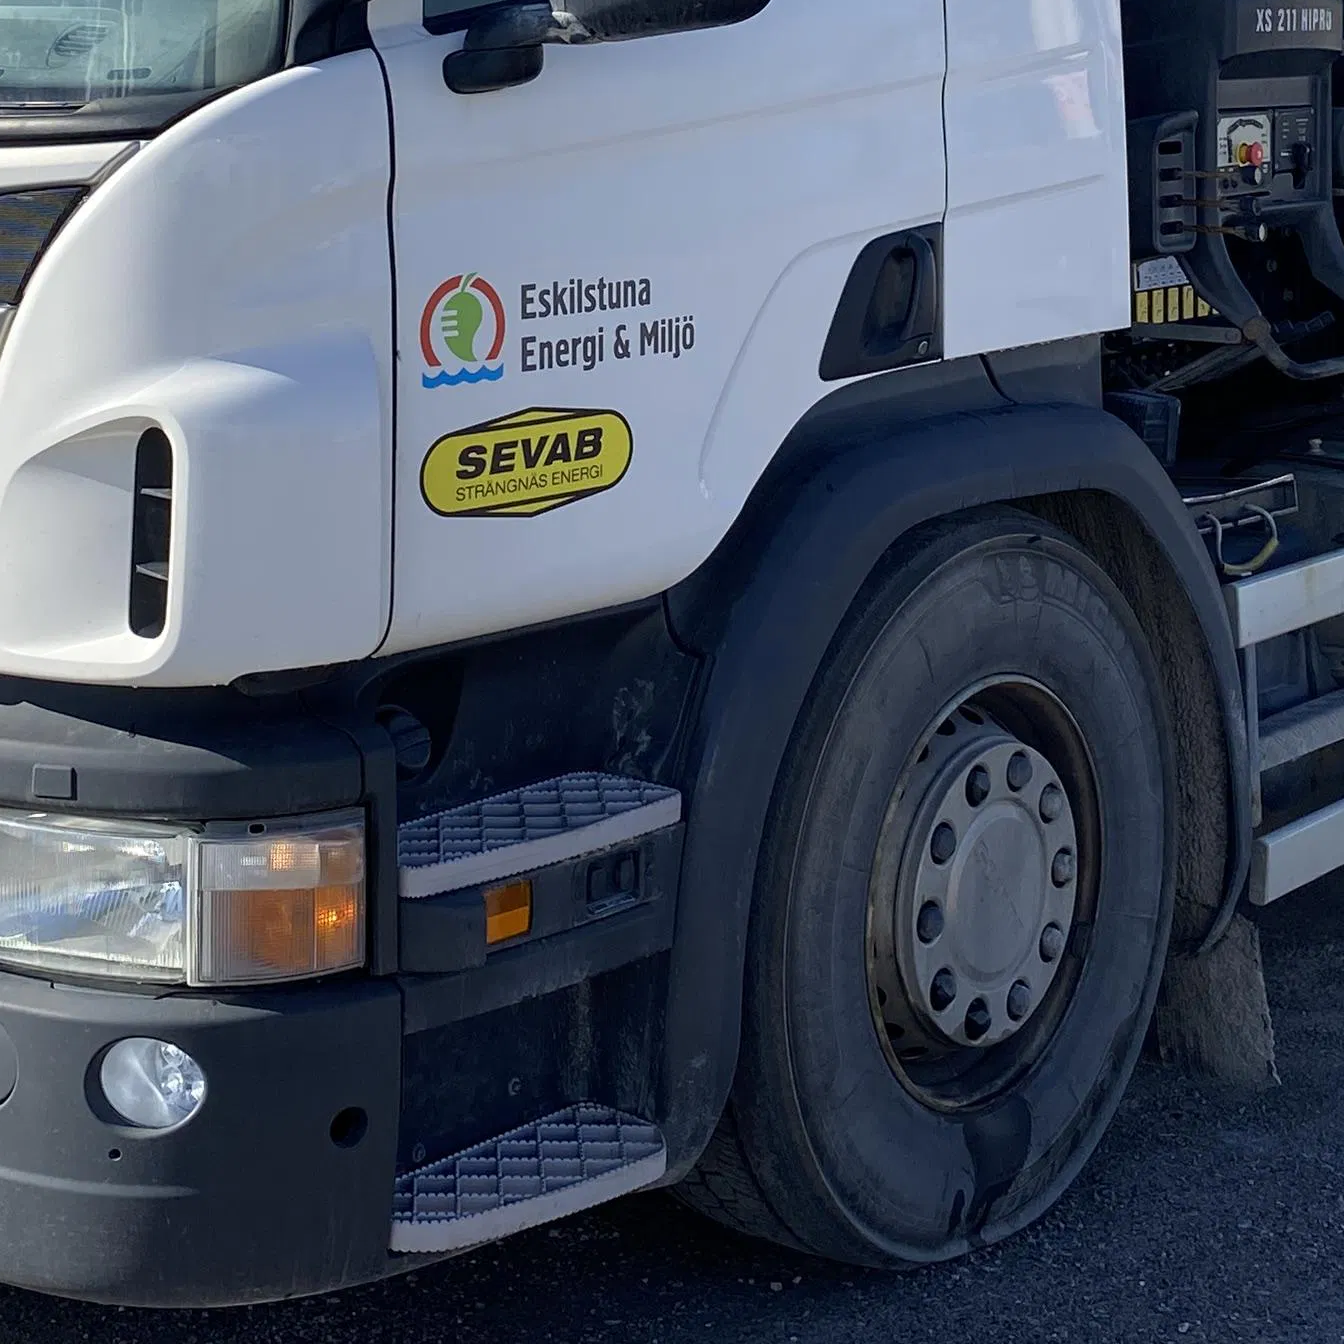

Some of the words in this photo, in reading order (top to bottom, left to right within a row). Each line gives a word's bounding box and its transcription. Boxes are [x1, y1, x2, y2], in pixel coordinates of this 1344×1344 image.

[1256, 8, 1273, 32] XS
[1277, 8, 1297, 32] 211
[1301, 8, 1333, 31] HIPRO
[520, 276, 652, 320] Eskilstuna
[520, 326, 605, 373] Energi
[613, 324, 632, 360] &
[639, 315, 696, 359] Miljö
[456, 427, 604, 480] SEVAB
[456, 473, 549, 502] STRÄNGNÄS
[551, 463, 604, 486] ENERGI
